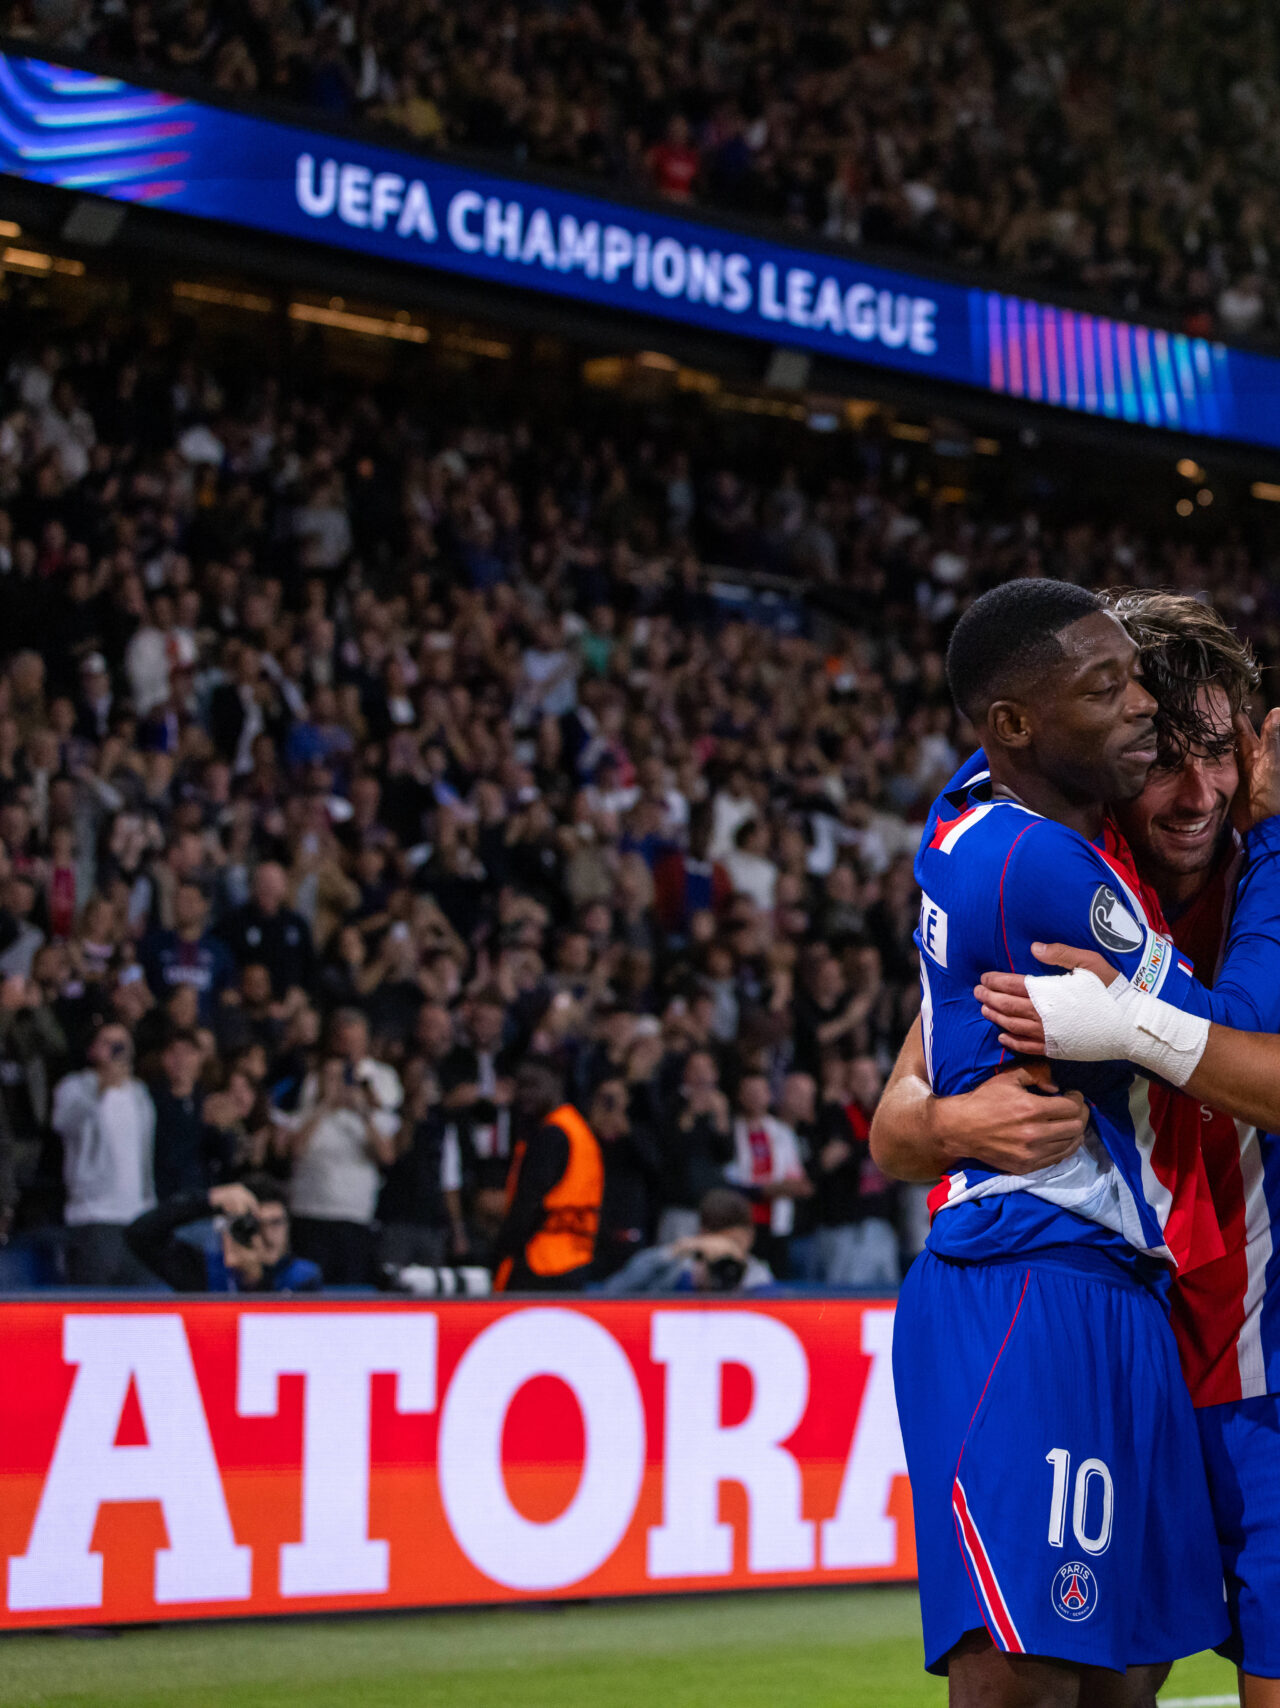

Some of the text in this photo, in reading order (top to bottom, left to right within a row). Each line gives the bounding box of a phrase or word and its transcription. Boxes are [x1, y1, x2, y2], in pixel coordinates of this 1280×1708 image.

[296, 153, 938, 356] UEFA CHAMPIONS LEAGUE
[1133, 966, 1146, 987] UEFA
[1045, 1447, 1115, 1557] 10
[1060, 1564, 1090, 1580] PARIS
